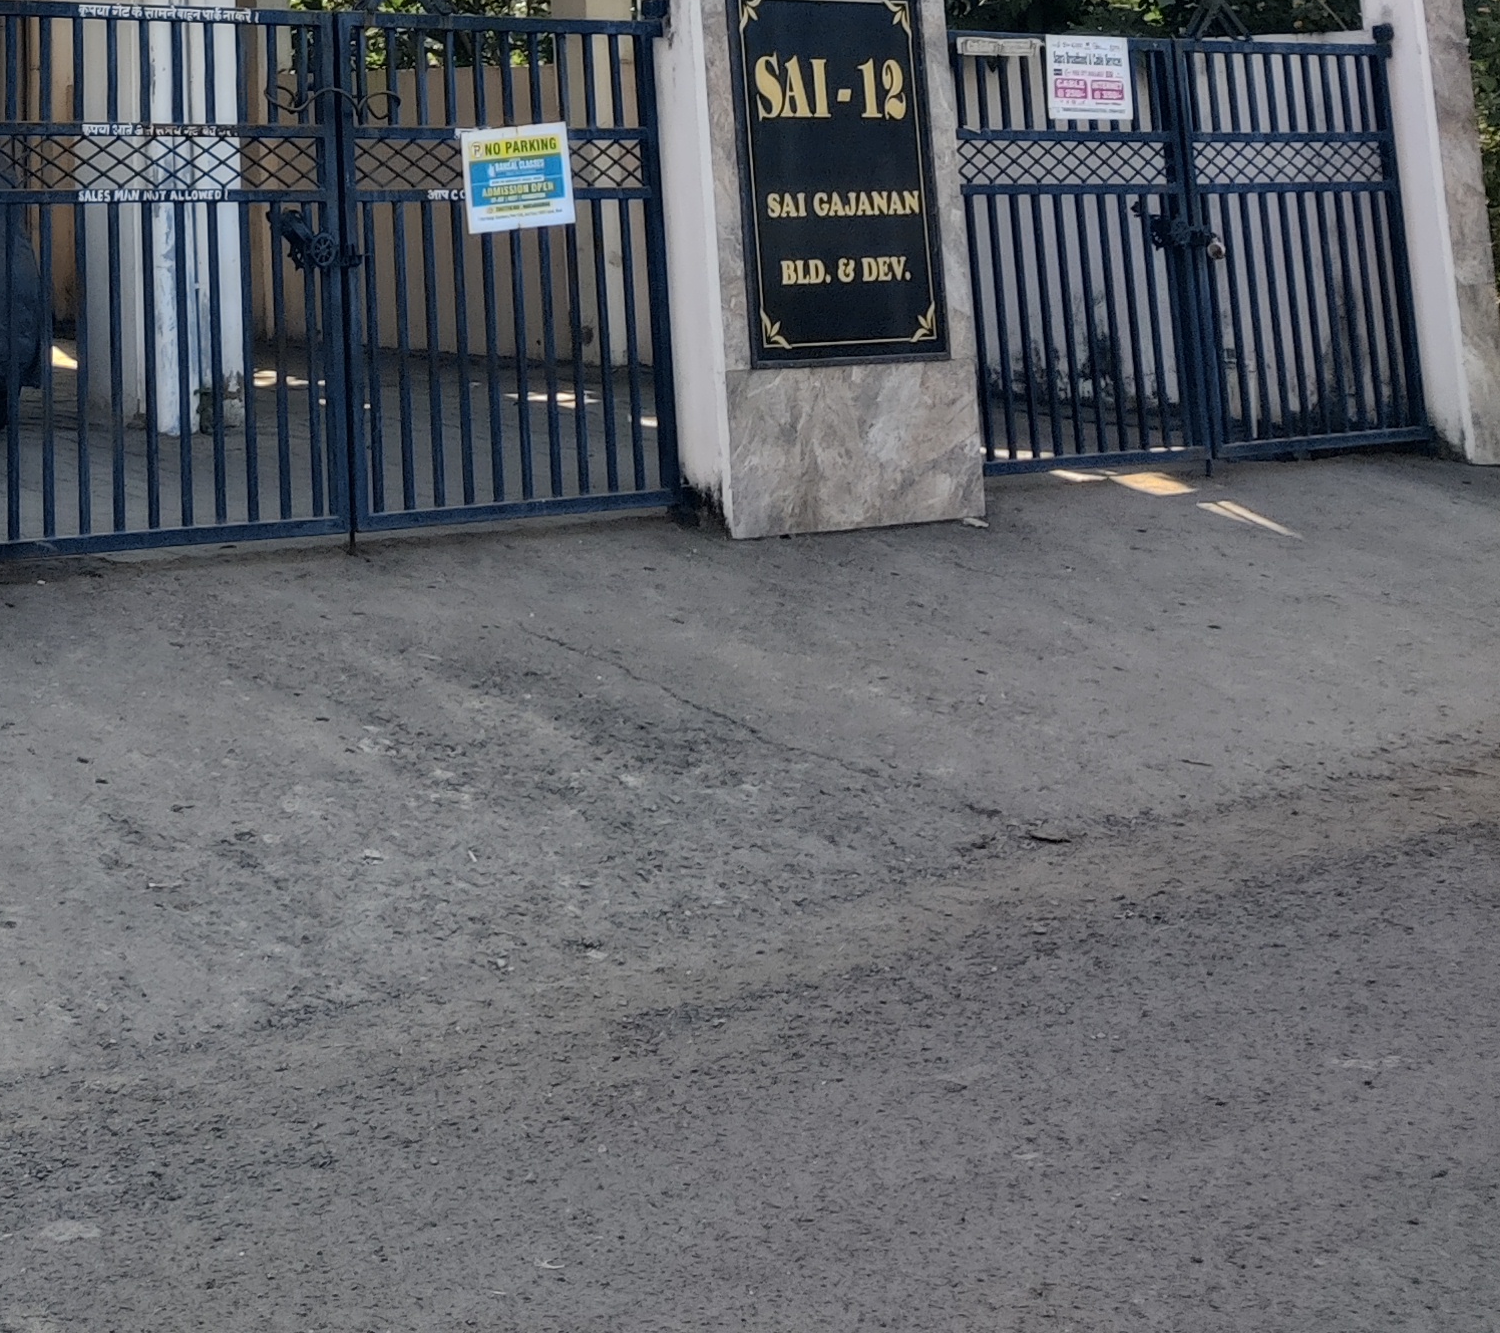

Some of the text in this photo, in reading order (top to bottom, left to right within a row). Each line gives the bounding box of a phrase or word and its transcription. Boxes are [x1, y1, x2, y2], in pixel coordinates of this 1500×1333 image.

[78, 4, 109, 18] कृपया
[144, 4, 176, 20] सामने
[484, 137, 557, 156] NO PARKING
[78, 189, 110, 202] SALES
[114, 189, 140, 202] MAN
[144, 189, 167, 201] NOT
[170, 189, 222, 201] ALLOWED
[482, 183, 529, 198] ADMISSION
[531, 181, 555, 193] OPEN
[767, 190, 920, 219] SAI GAJANAN
[780, 256, 912, 286] BLD. & DEV.
